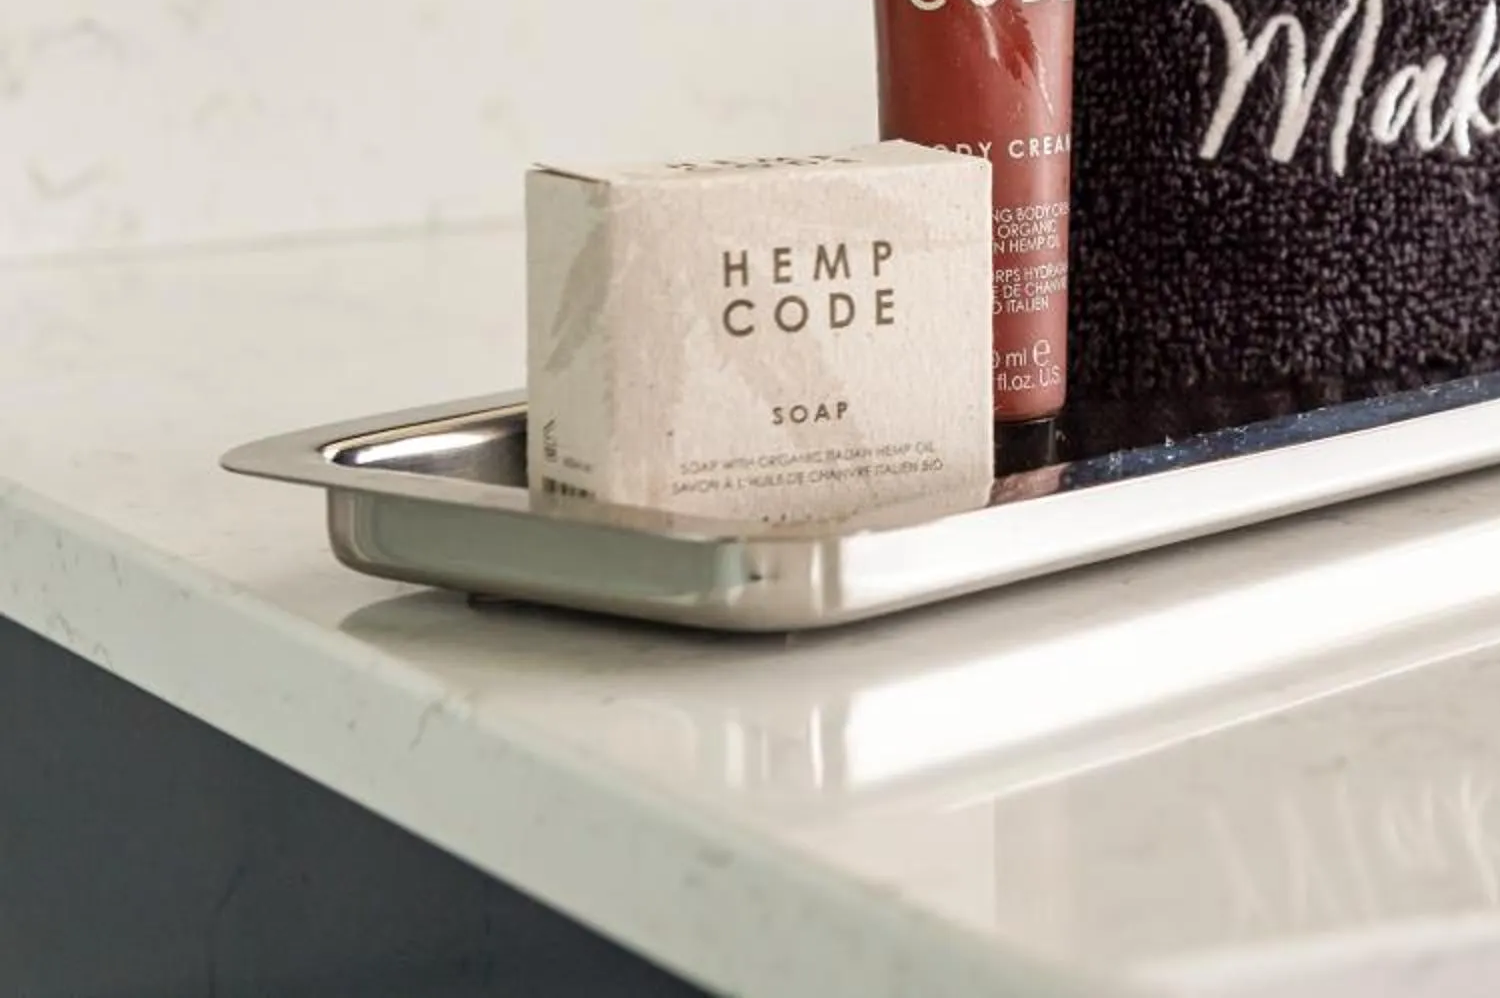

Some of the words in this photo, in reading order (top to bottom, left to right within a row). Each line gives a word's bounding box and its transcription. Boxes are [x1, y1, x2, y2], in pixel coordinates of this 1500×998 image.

[723, 240, 893, 288] HEMP
[993, 268, 1021, 283] RPS
[1003, 283, 1021, 299] DE
[723, 288, 896, 337] CODE
[1005, 347, 1028, 368] ml
[1039, 365, 1061, 387] US
[772, 402, 850, 426] SOAP
